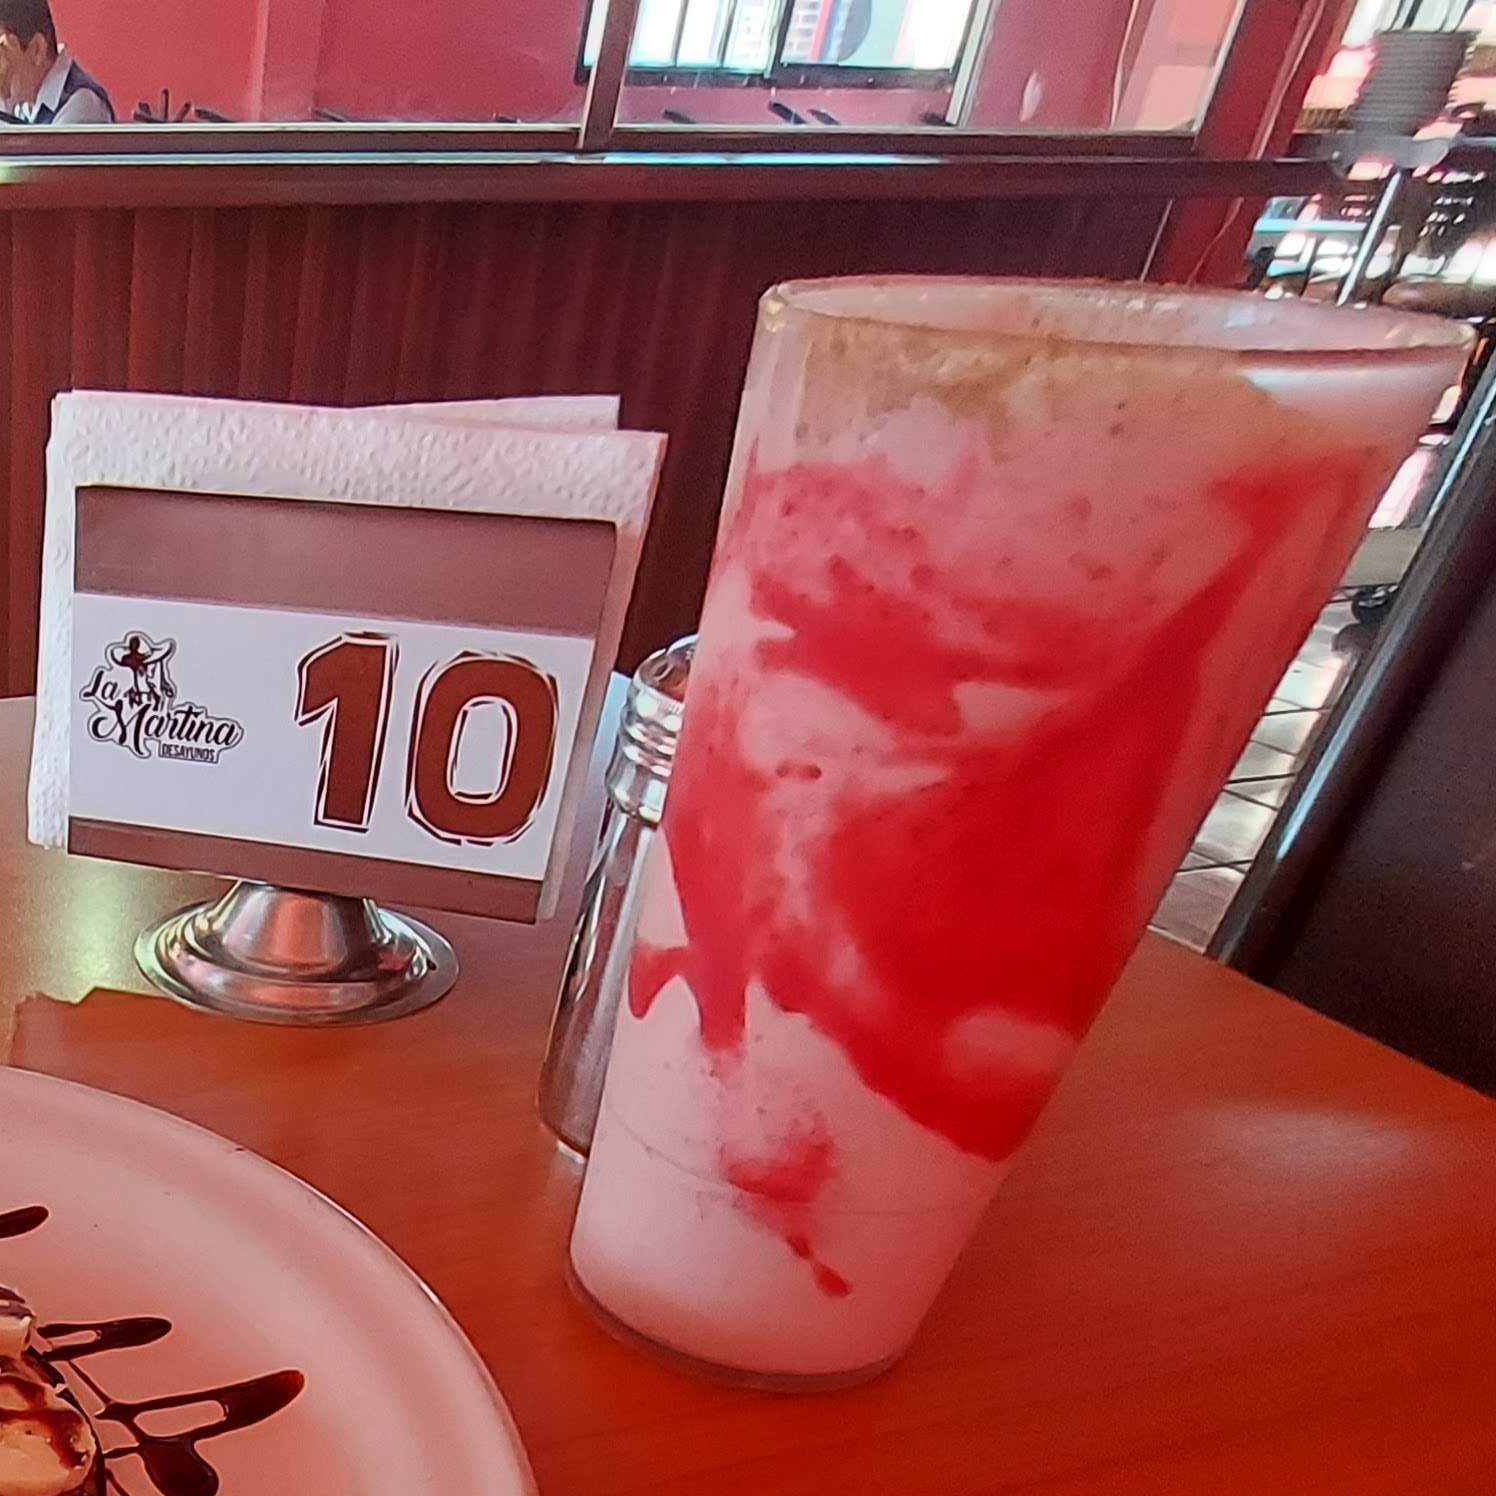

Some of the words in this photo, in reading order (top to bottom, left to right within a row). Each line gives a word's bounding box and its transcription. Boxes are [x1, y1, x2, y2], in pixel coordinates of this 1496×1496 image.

[83, 670, 119, 700] La
[92, 699, 239, 755] Martina
[296, 632, 559, 845] 10
[162, 743, 215, 762] DESAYUNOS
